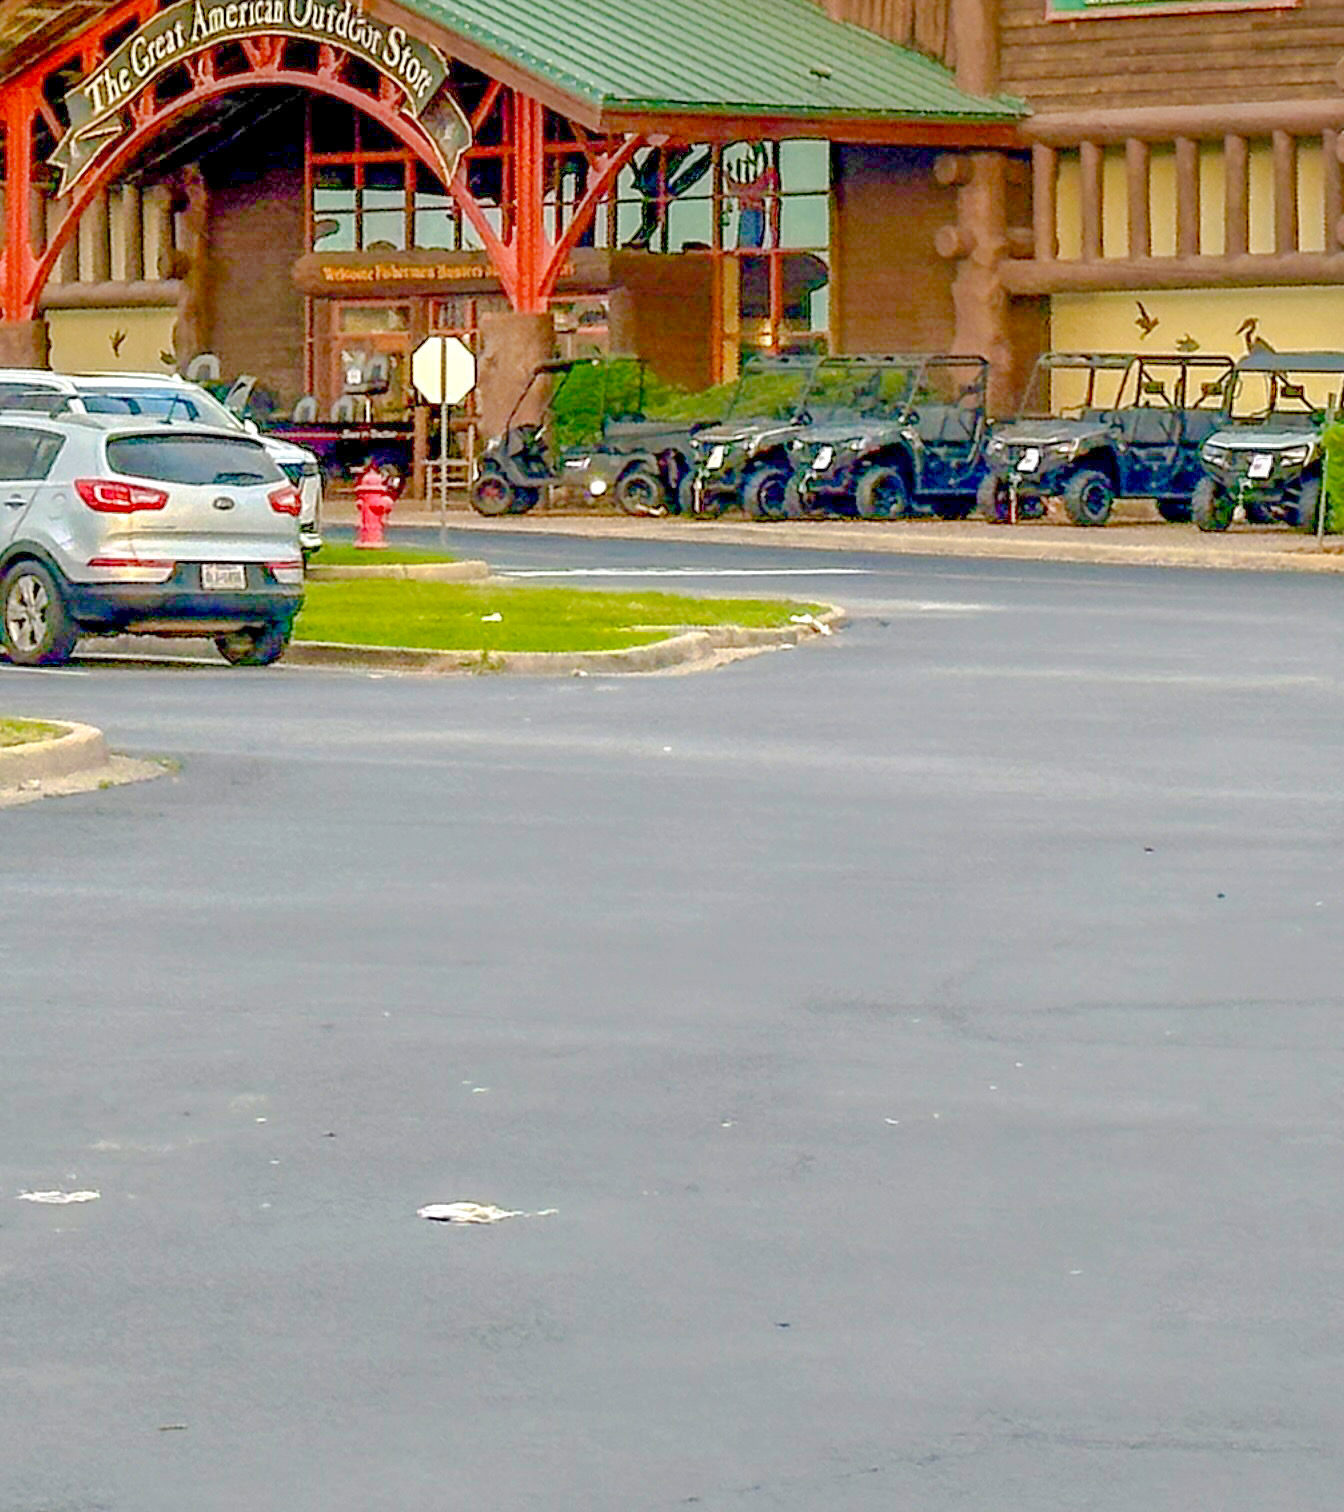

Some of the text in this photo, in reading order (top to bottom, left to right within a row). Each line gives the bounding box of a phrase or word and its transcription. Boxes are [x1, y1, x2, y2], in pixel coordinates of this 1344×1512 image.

[84, 68, 132, 116] The
[130, 20, 185, 78] Great
[382, 26, 433, 98] Store
